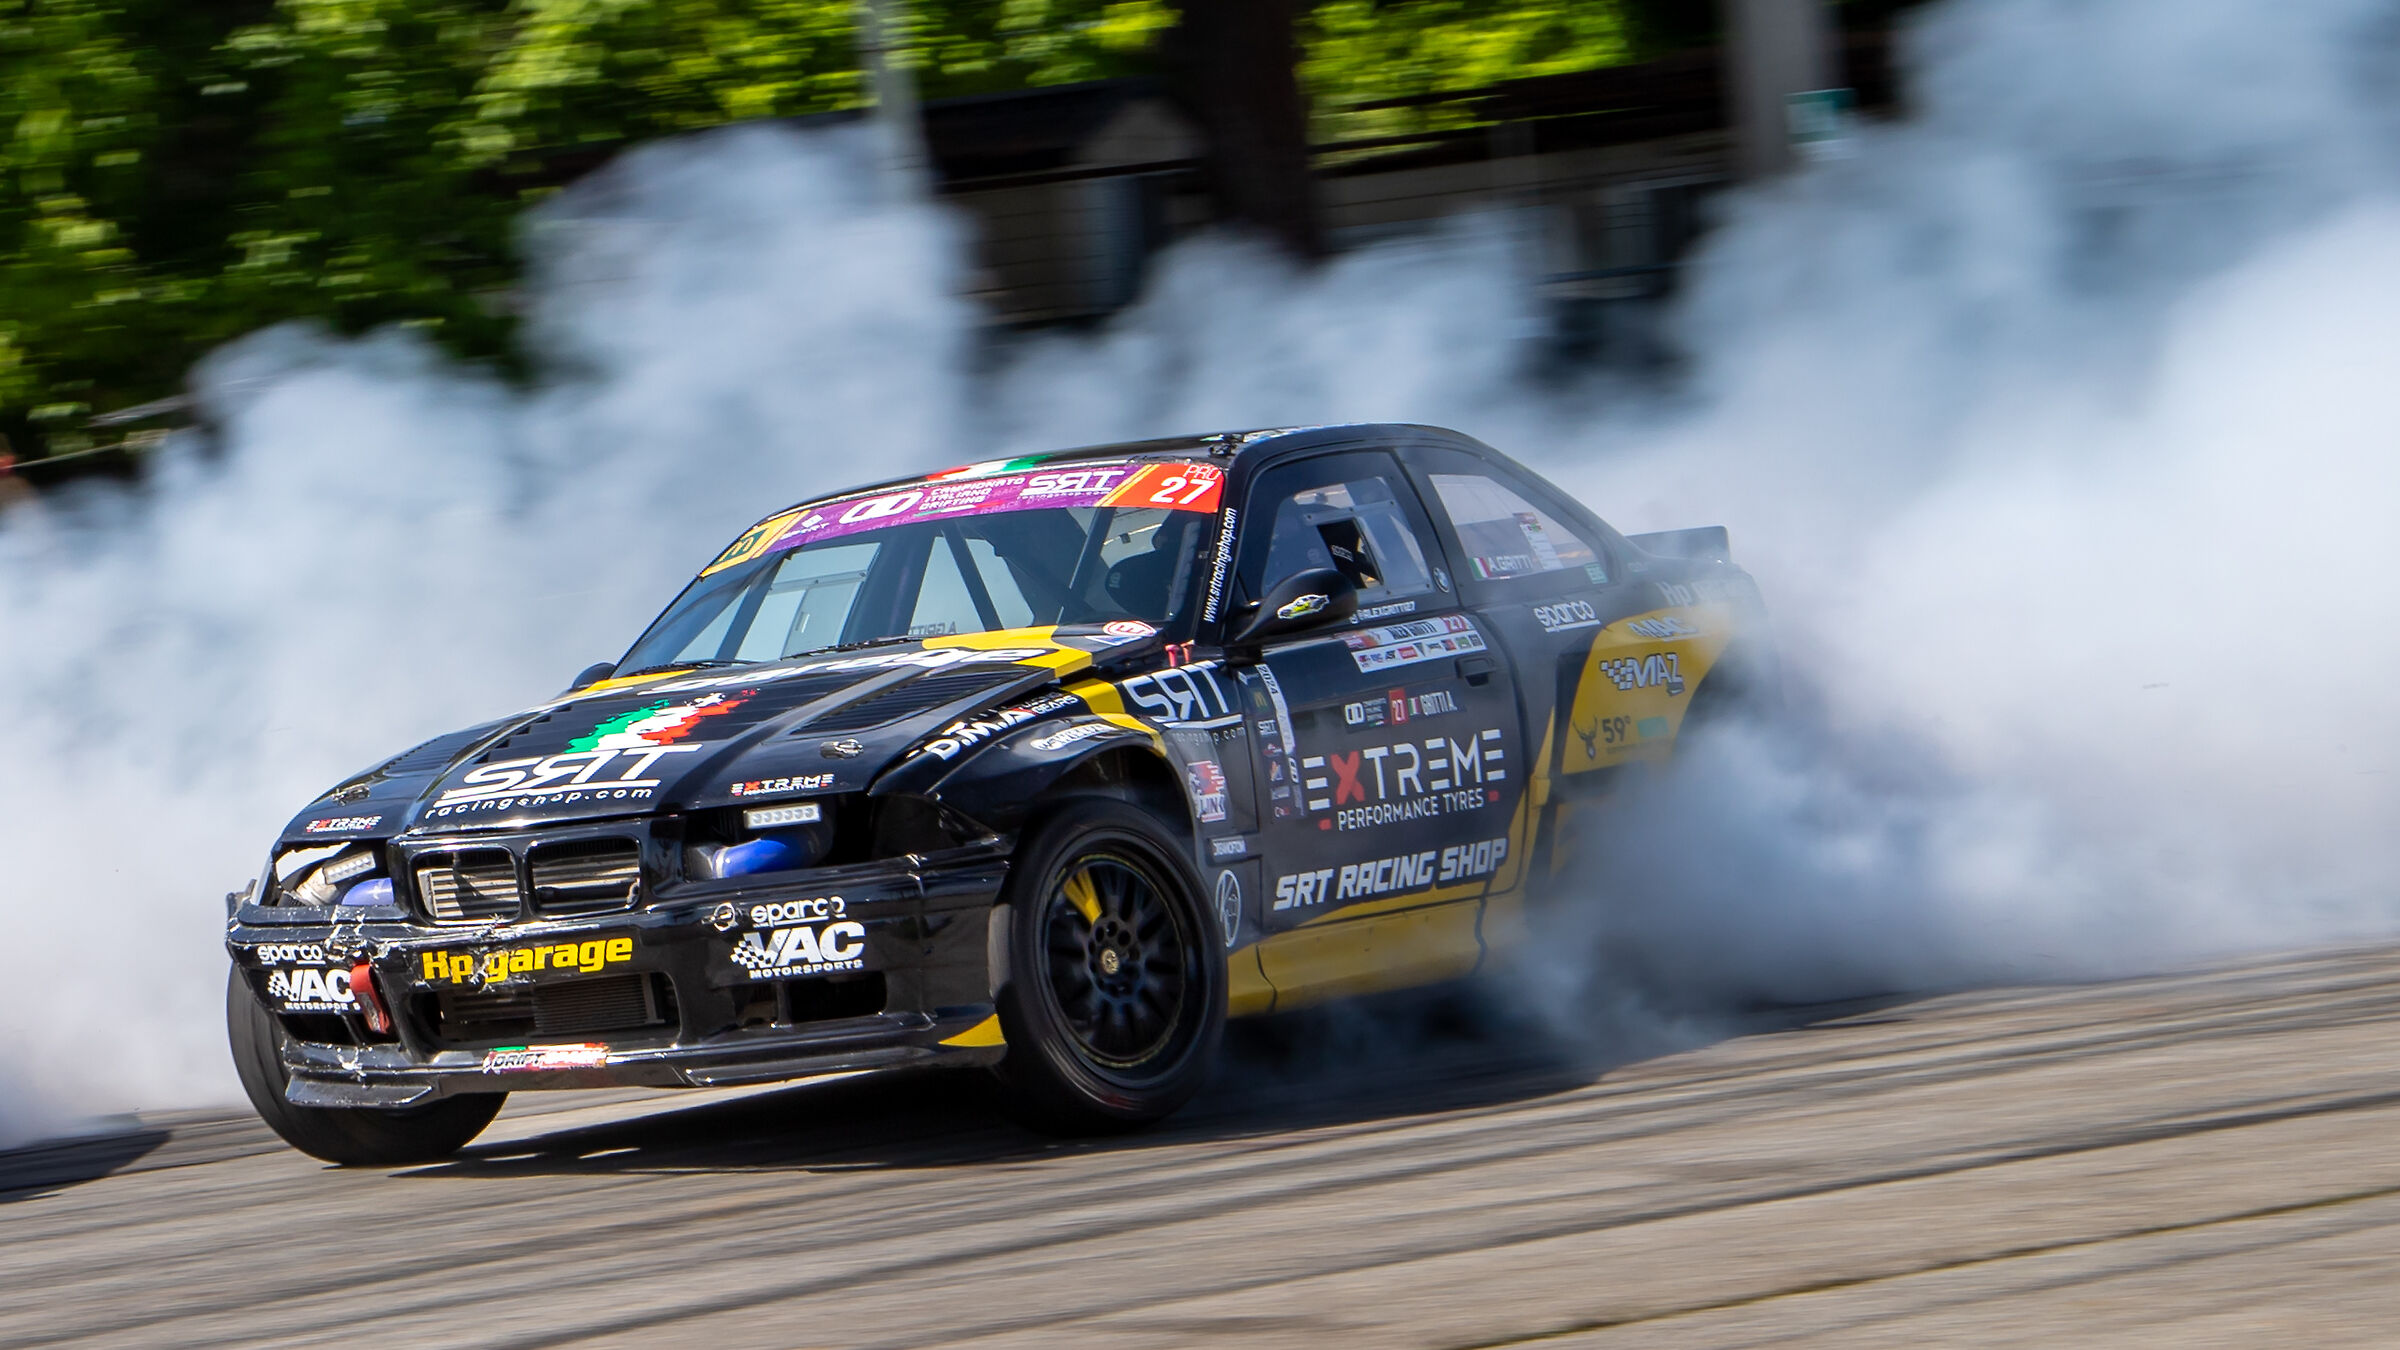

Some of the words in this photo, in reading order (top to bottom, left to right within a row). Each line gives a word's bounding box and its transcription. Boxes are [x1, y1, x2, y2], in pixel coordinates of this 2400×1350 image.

[1182, 465, 1221, 480] PRO
[924, 488, 993, 503] ITALIANO
[930, 477, 1026, 496] CAMPIONATO
[1150, 477, 1214, 504] 27
[919, 496, 986, 511] DRIFTING
[1202, 507, 1238, 623] www.srtracingshop.com
[1533, 600, 1598, 632] sparco
[1031, 695, 1079, 714] GEARS
[1302, 729, 1506, 811] EXTREME
[731, 774, 835, 794] EXTREME
[425, 787, 653, 820] racingshop.com
[1337, 796, 1439, 831] PERFORMANCE
[1442, 787, 1485, 812] TYRES
[306, 816, 382, 830] EXTREME
[1273, 868, 1334, 911] SRT
[1336, 850, 1437, 900] RACING
[1438, 837, 1508, 882] SHOP
[750, 896, 846, 925] sparco
[257, 944, 323, 965] sparco
[736, 921, 866, 968] VAC
[422, 950, 476, 984] Hp
[482, 937, 634, 984] garage
[749, 959, 864, 980] MOTORSPORTS
[268, 968, 356, 1003] VAC
[284, 1002, 361, 1011] MOTORSPORS
